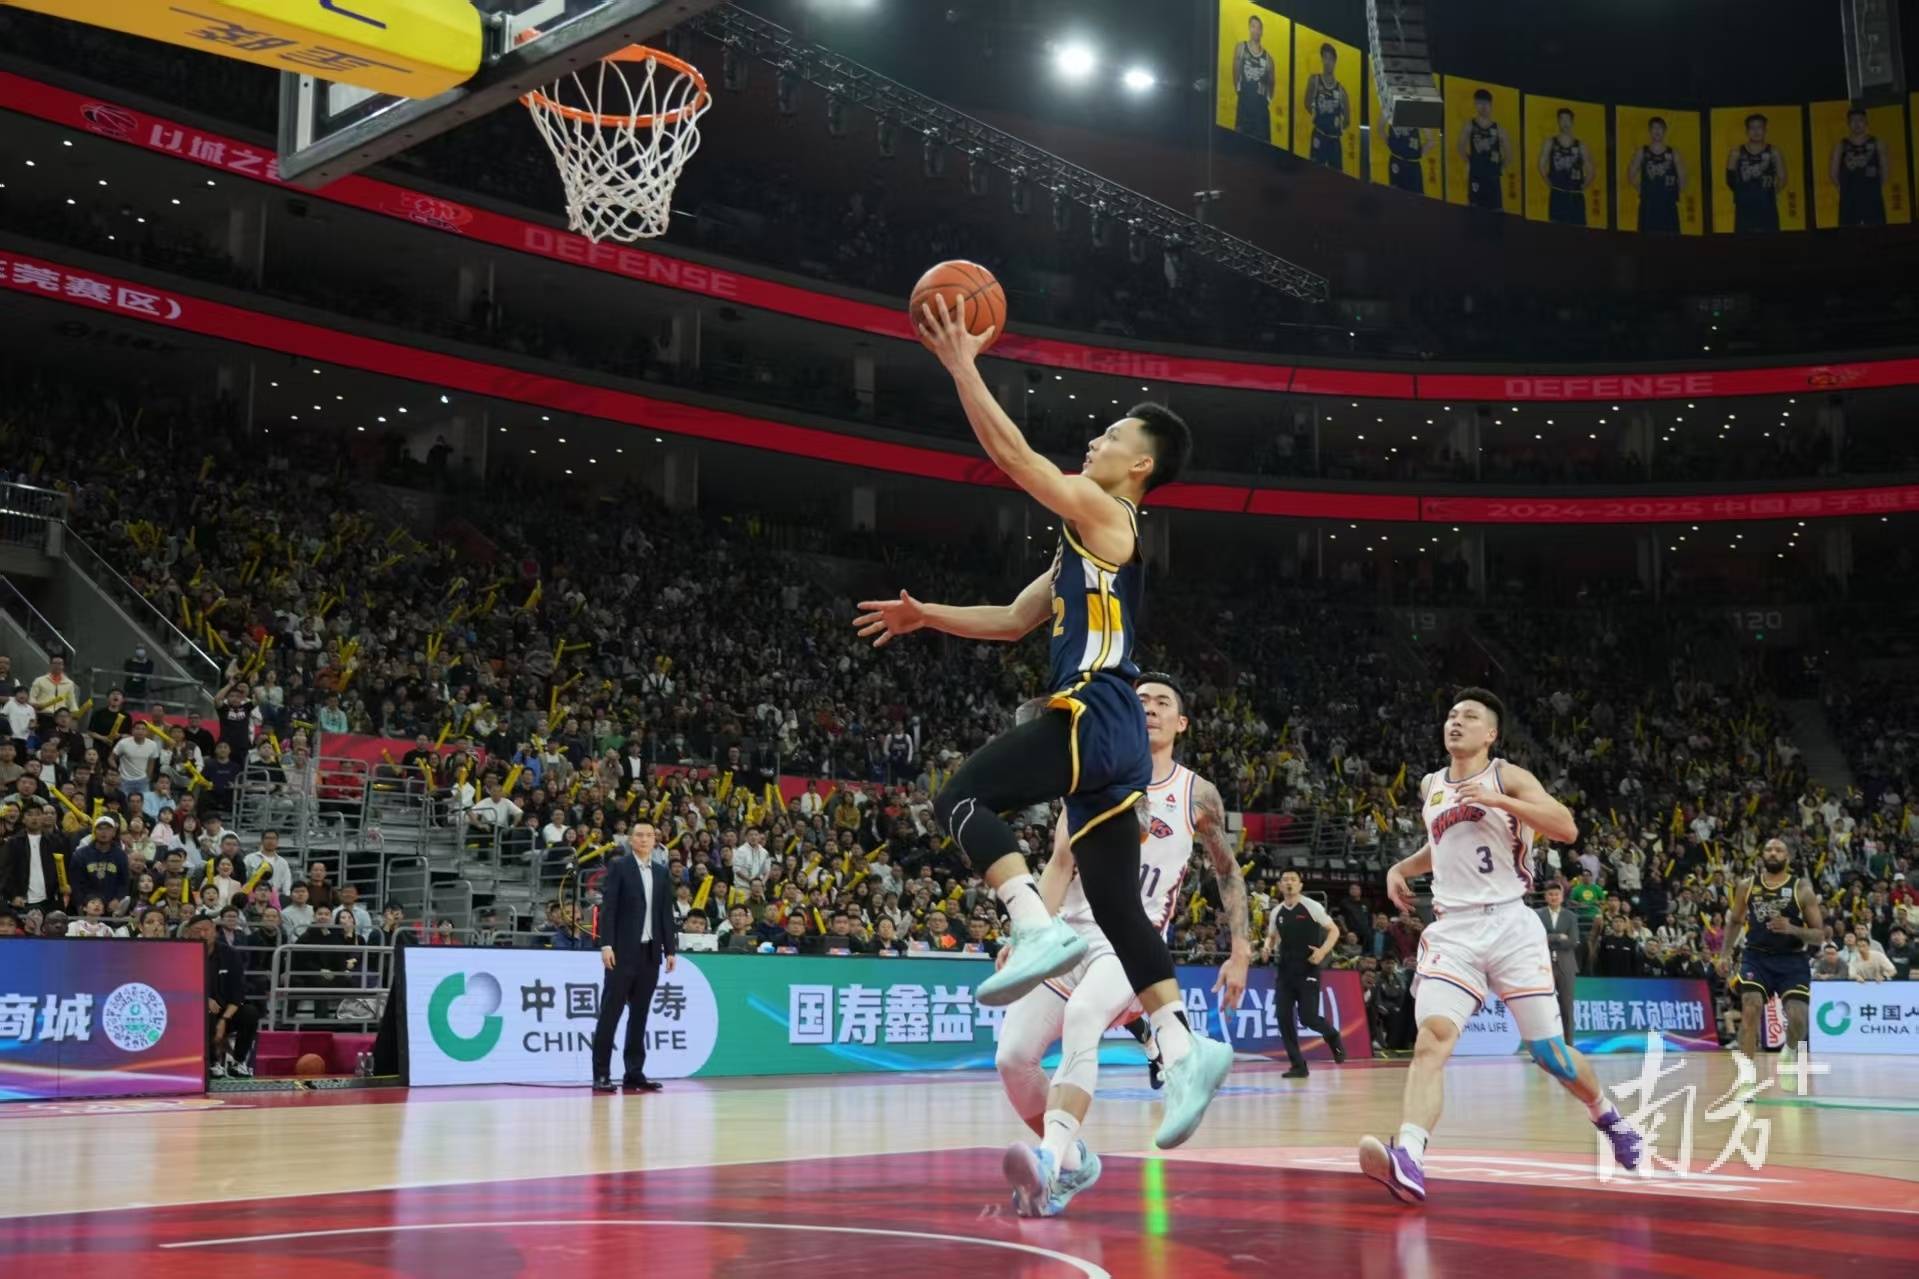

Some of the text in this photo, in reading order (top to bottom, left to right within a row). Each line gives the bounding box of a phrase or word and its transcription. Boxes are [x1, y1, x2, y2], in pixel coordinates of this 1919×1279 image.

[524, 226, 737, 297] DEFENSE
[1505, 374, 1714, 398] DEFENSE
[1732, 611, 1784, 631] 120
[1476, 845, 1494, 874] 3
[1140, 863, 1161, 898] 11
[520, 978, 687, 1023] 中国寿
[0, 992, 93, 1042] 商城
[1463, 1022, 1508, 1033] HINA LIFE
[1860, 1025, 1910, 1034] CHINA
[522, 1030, 687, 1053] CHIN IFE
